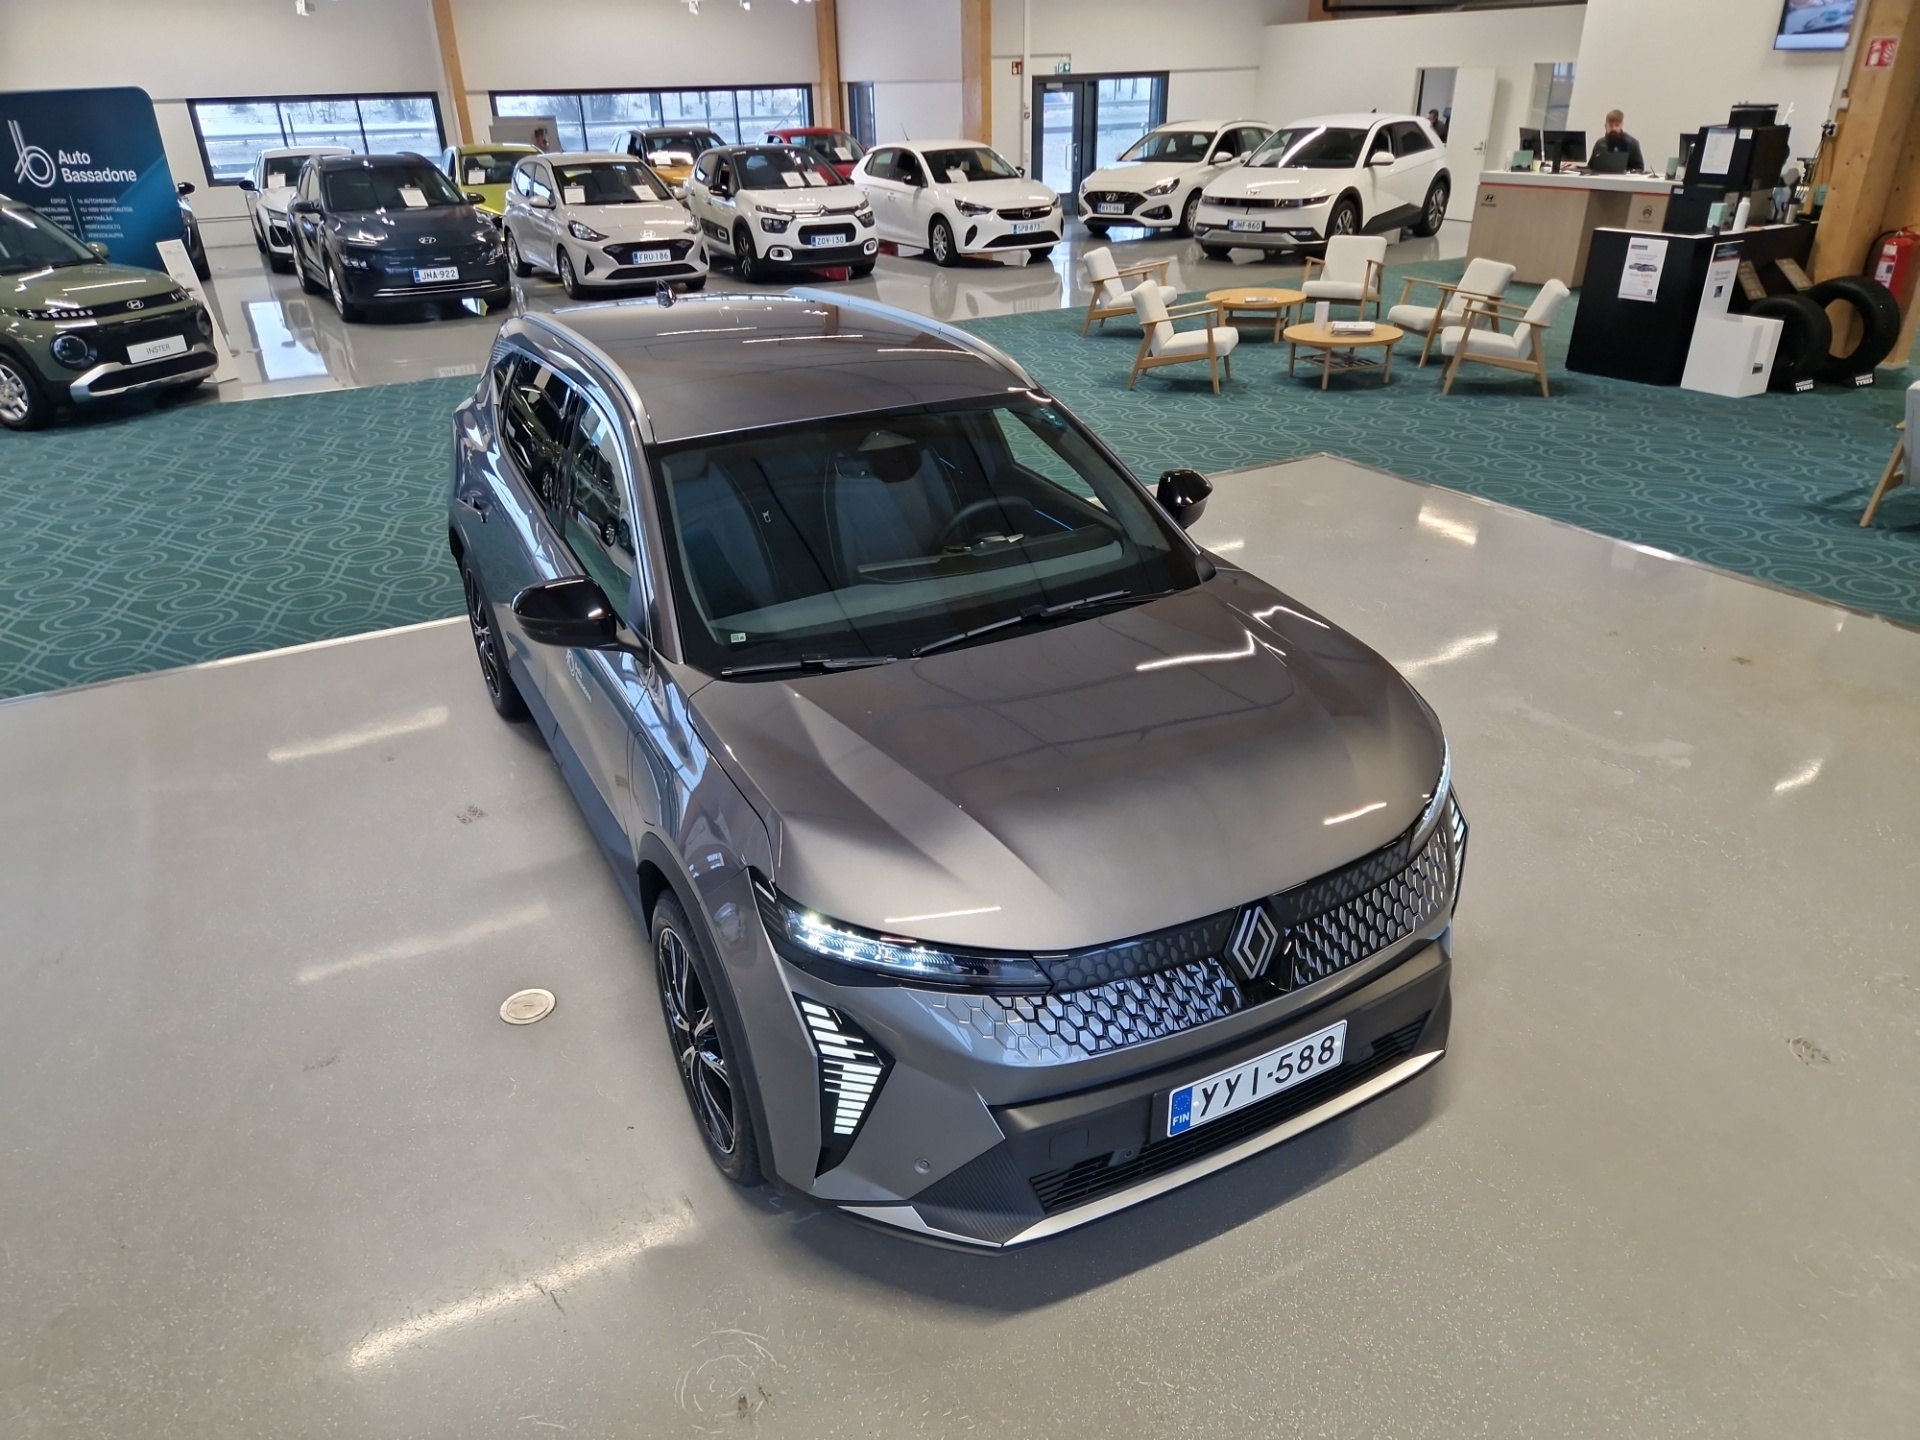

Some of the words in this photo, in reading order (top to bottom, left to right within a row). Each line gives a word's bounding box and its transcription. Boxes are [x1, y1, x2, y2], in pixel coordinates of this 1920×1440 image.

[58, 149, 91, 165] Auto
[61, 167, 137, 183] Bassadone
[422, 269, 456, 280] JNA-922
[146, 343, 171, 355] INSTER
[1199, 1035, 1336, 1118] YYI-588
[1172, 1112, 1190, 1127] FIN
